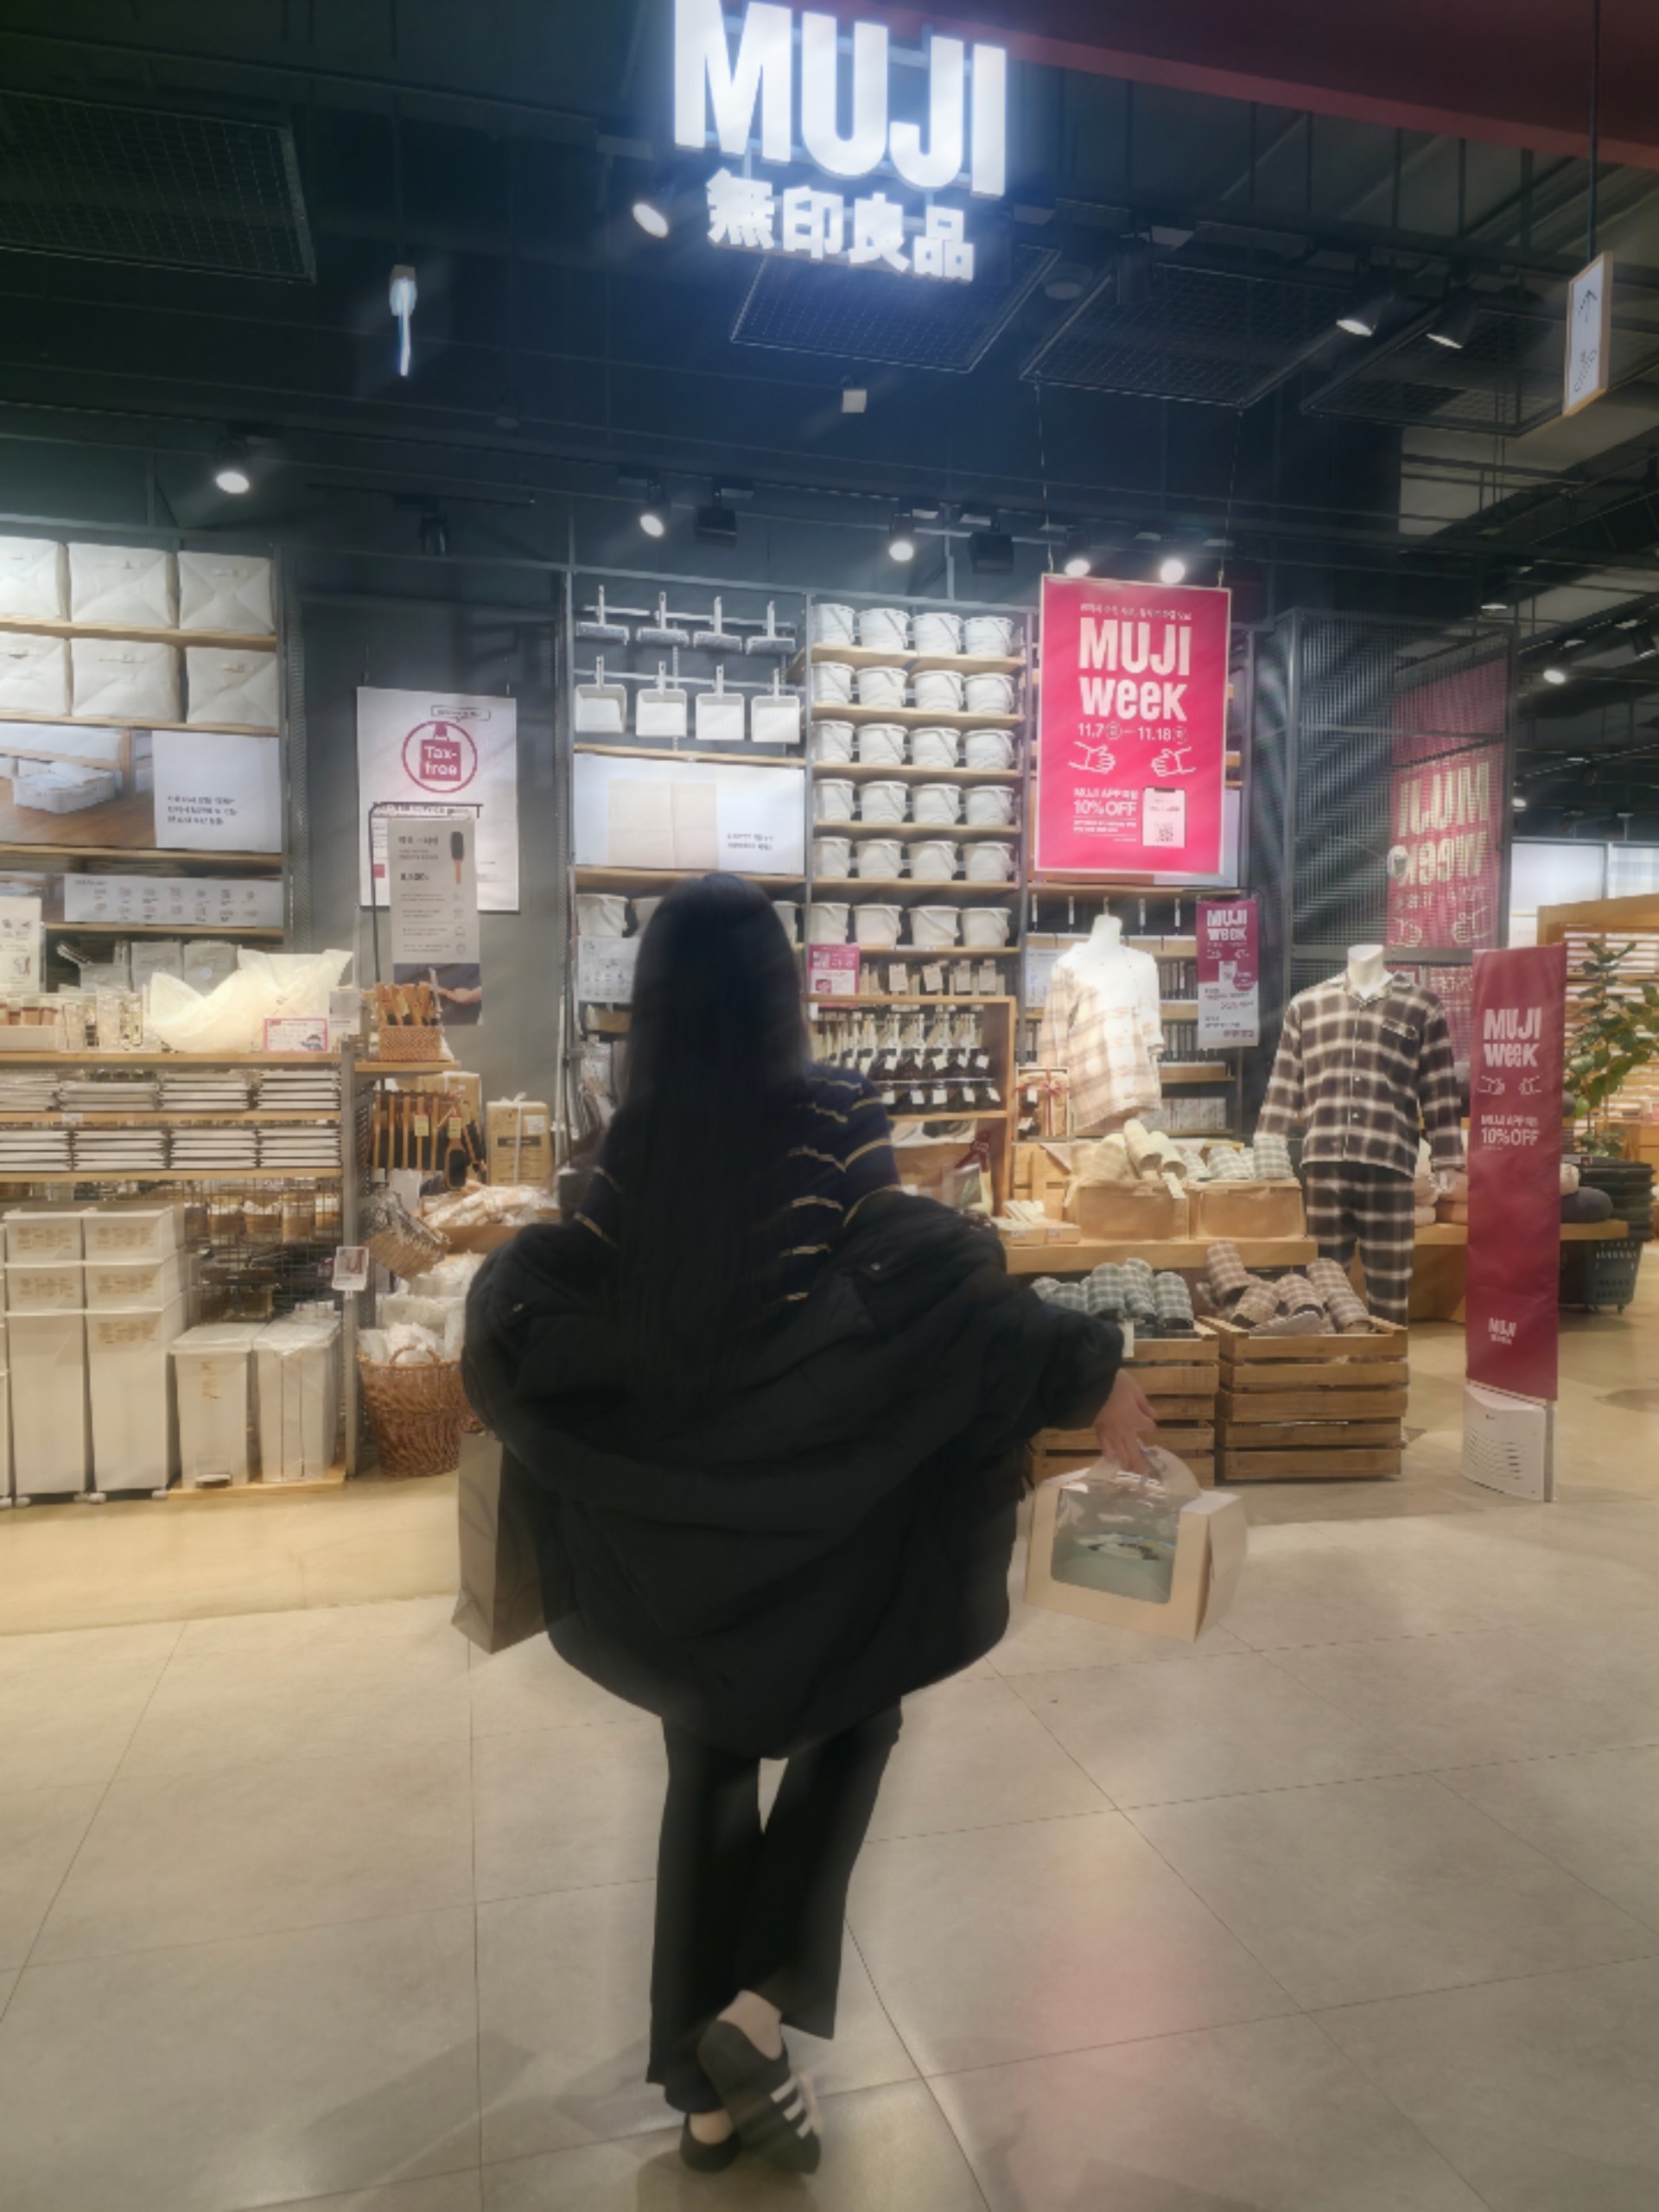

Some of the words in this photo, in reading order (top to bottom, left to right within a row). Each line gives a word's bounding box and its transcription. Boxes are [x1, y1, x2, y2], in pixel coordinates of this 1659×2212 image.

[674, 0, 1007, 200] MUJI
[705, 168, 976, 283] 無印良品
[1078, 617, 1192, 676] MUJI
[424, 746, 457, 760] Tax-
[425, 760, 457, 775] free
[1207, 909, 1248, 927] MUJI
[1484, 1007, 1541, 1040] MUJI
[1481, 1128, 1540, 1147] 10%OFF
